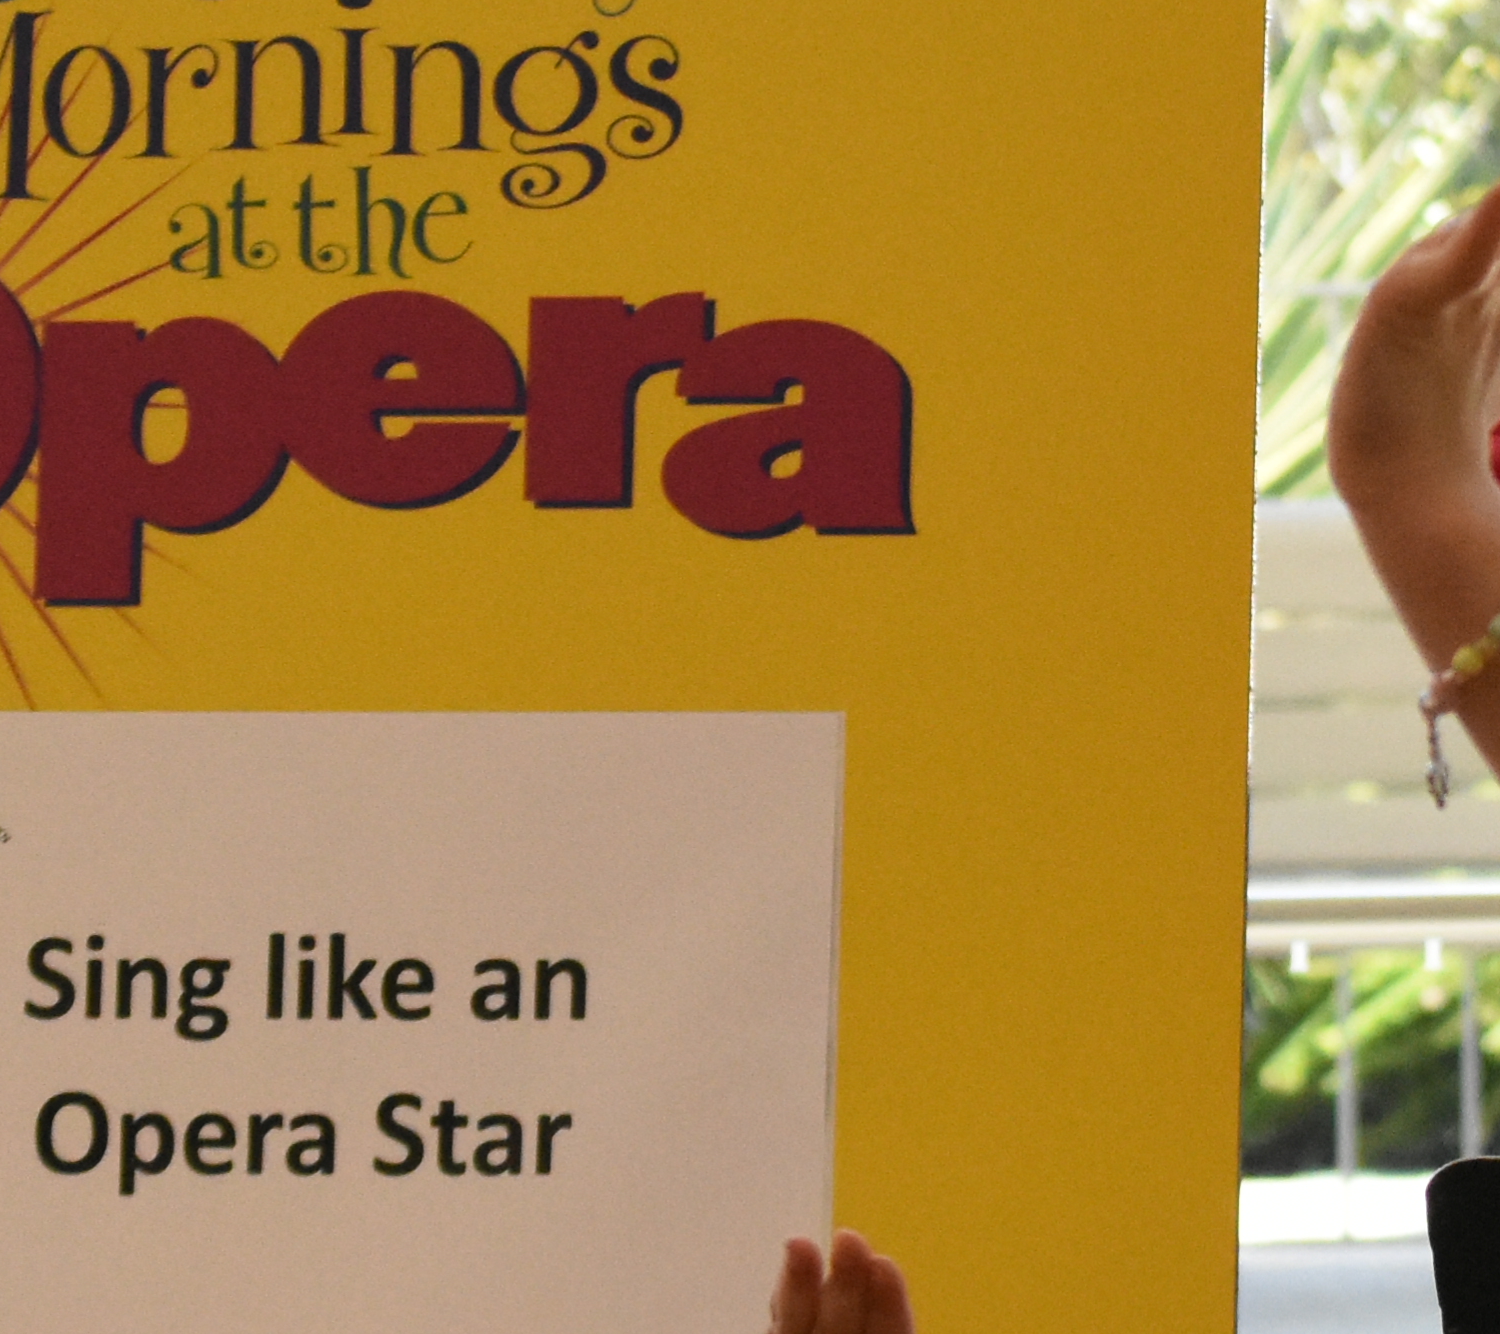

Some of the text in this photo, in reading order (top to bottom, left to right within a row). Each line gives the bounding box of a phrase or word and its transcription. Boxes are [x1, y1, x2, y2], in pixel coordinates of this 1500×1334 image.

[167, 165, 470, 278] at the
[24, 933, 587, 1041] Sing like an
[36, 1091, 572, 1196] Opera Star
